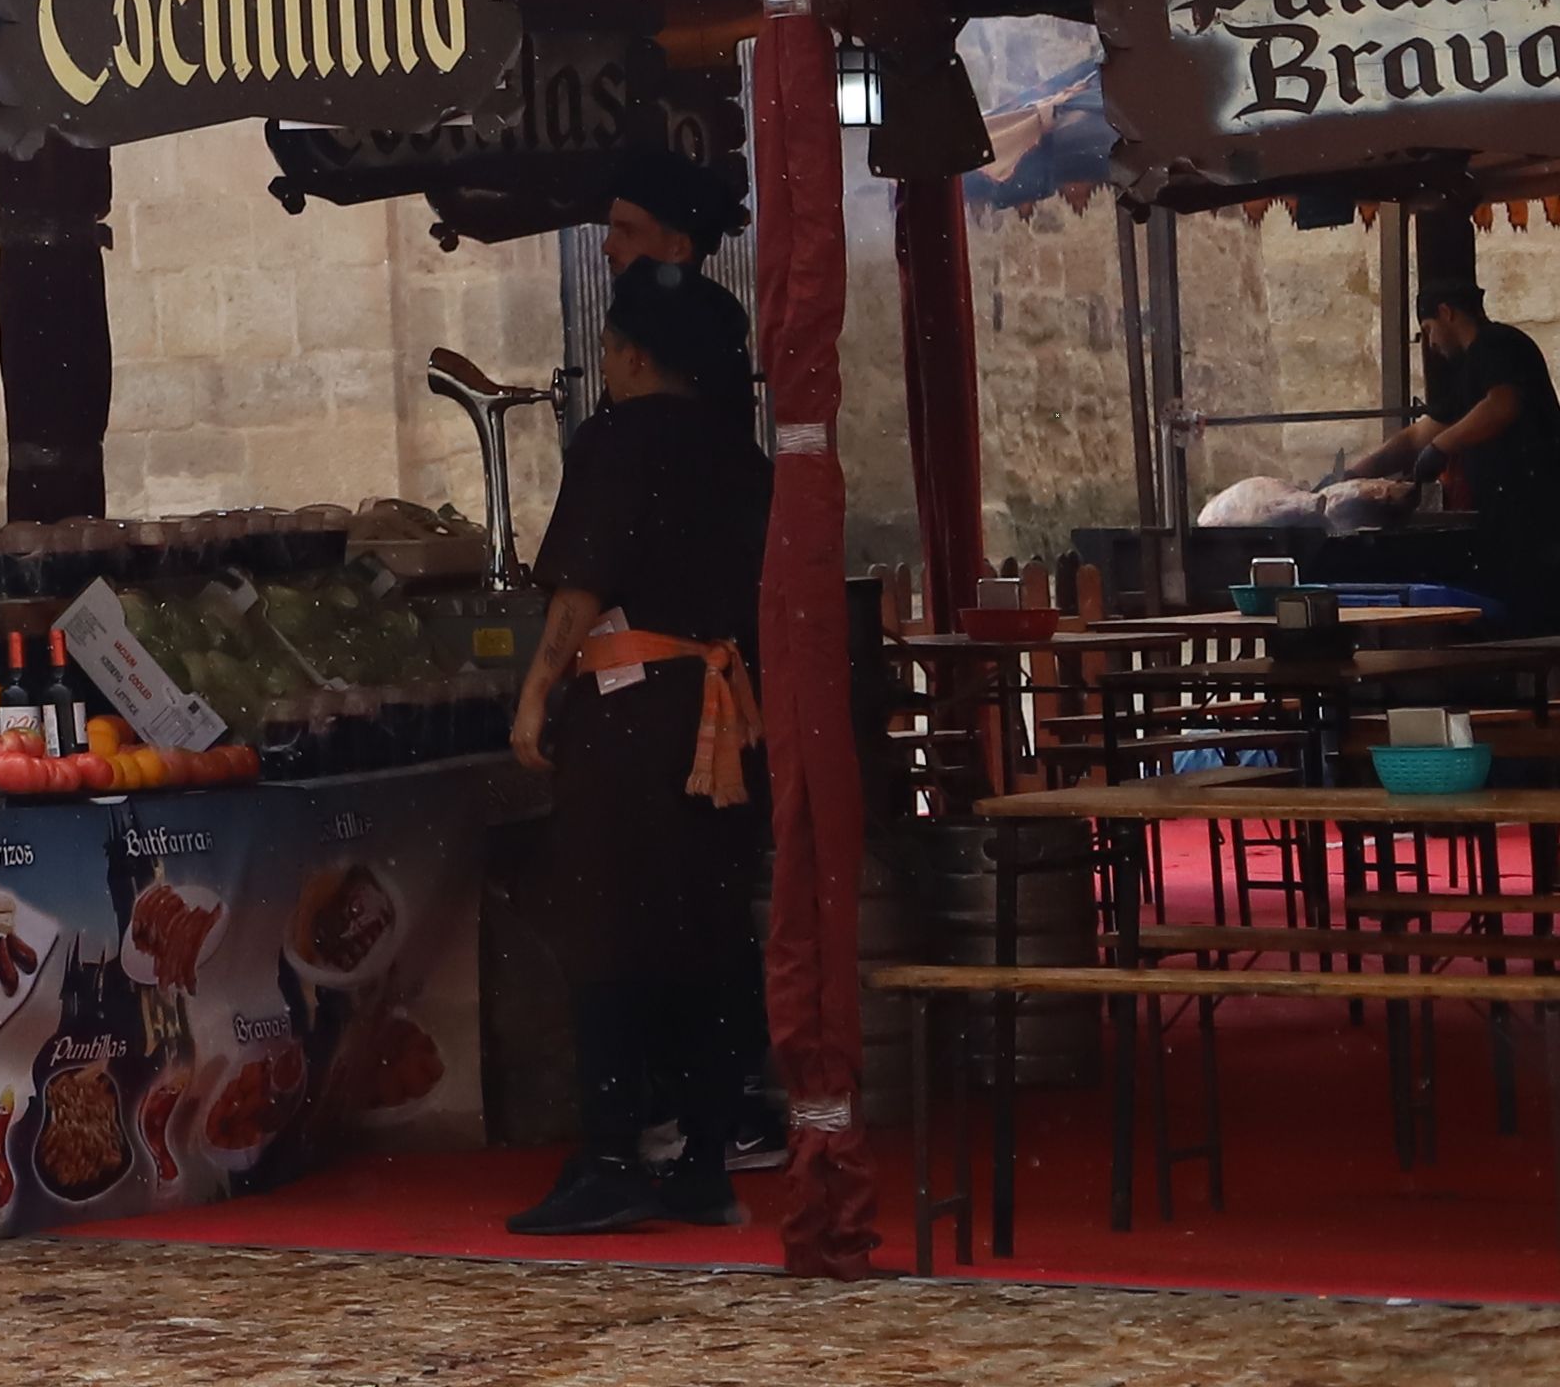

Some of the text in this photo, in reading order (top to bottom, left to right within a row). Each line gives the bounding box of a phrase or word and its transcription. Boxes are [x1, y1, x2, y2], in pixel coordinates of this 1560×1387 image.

[124, 826, 213, 857] Butifarras
[232, 1014, 290, 1043] Bravas
[49, 1033, 127, 1067] Puntillas
